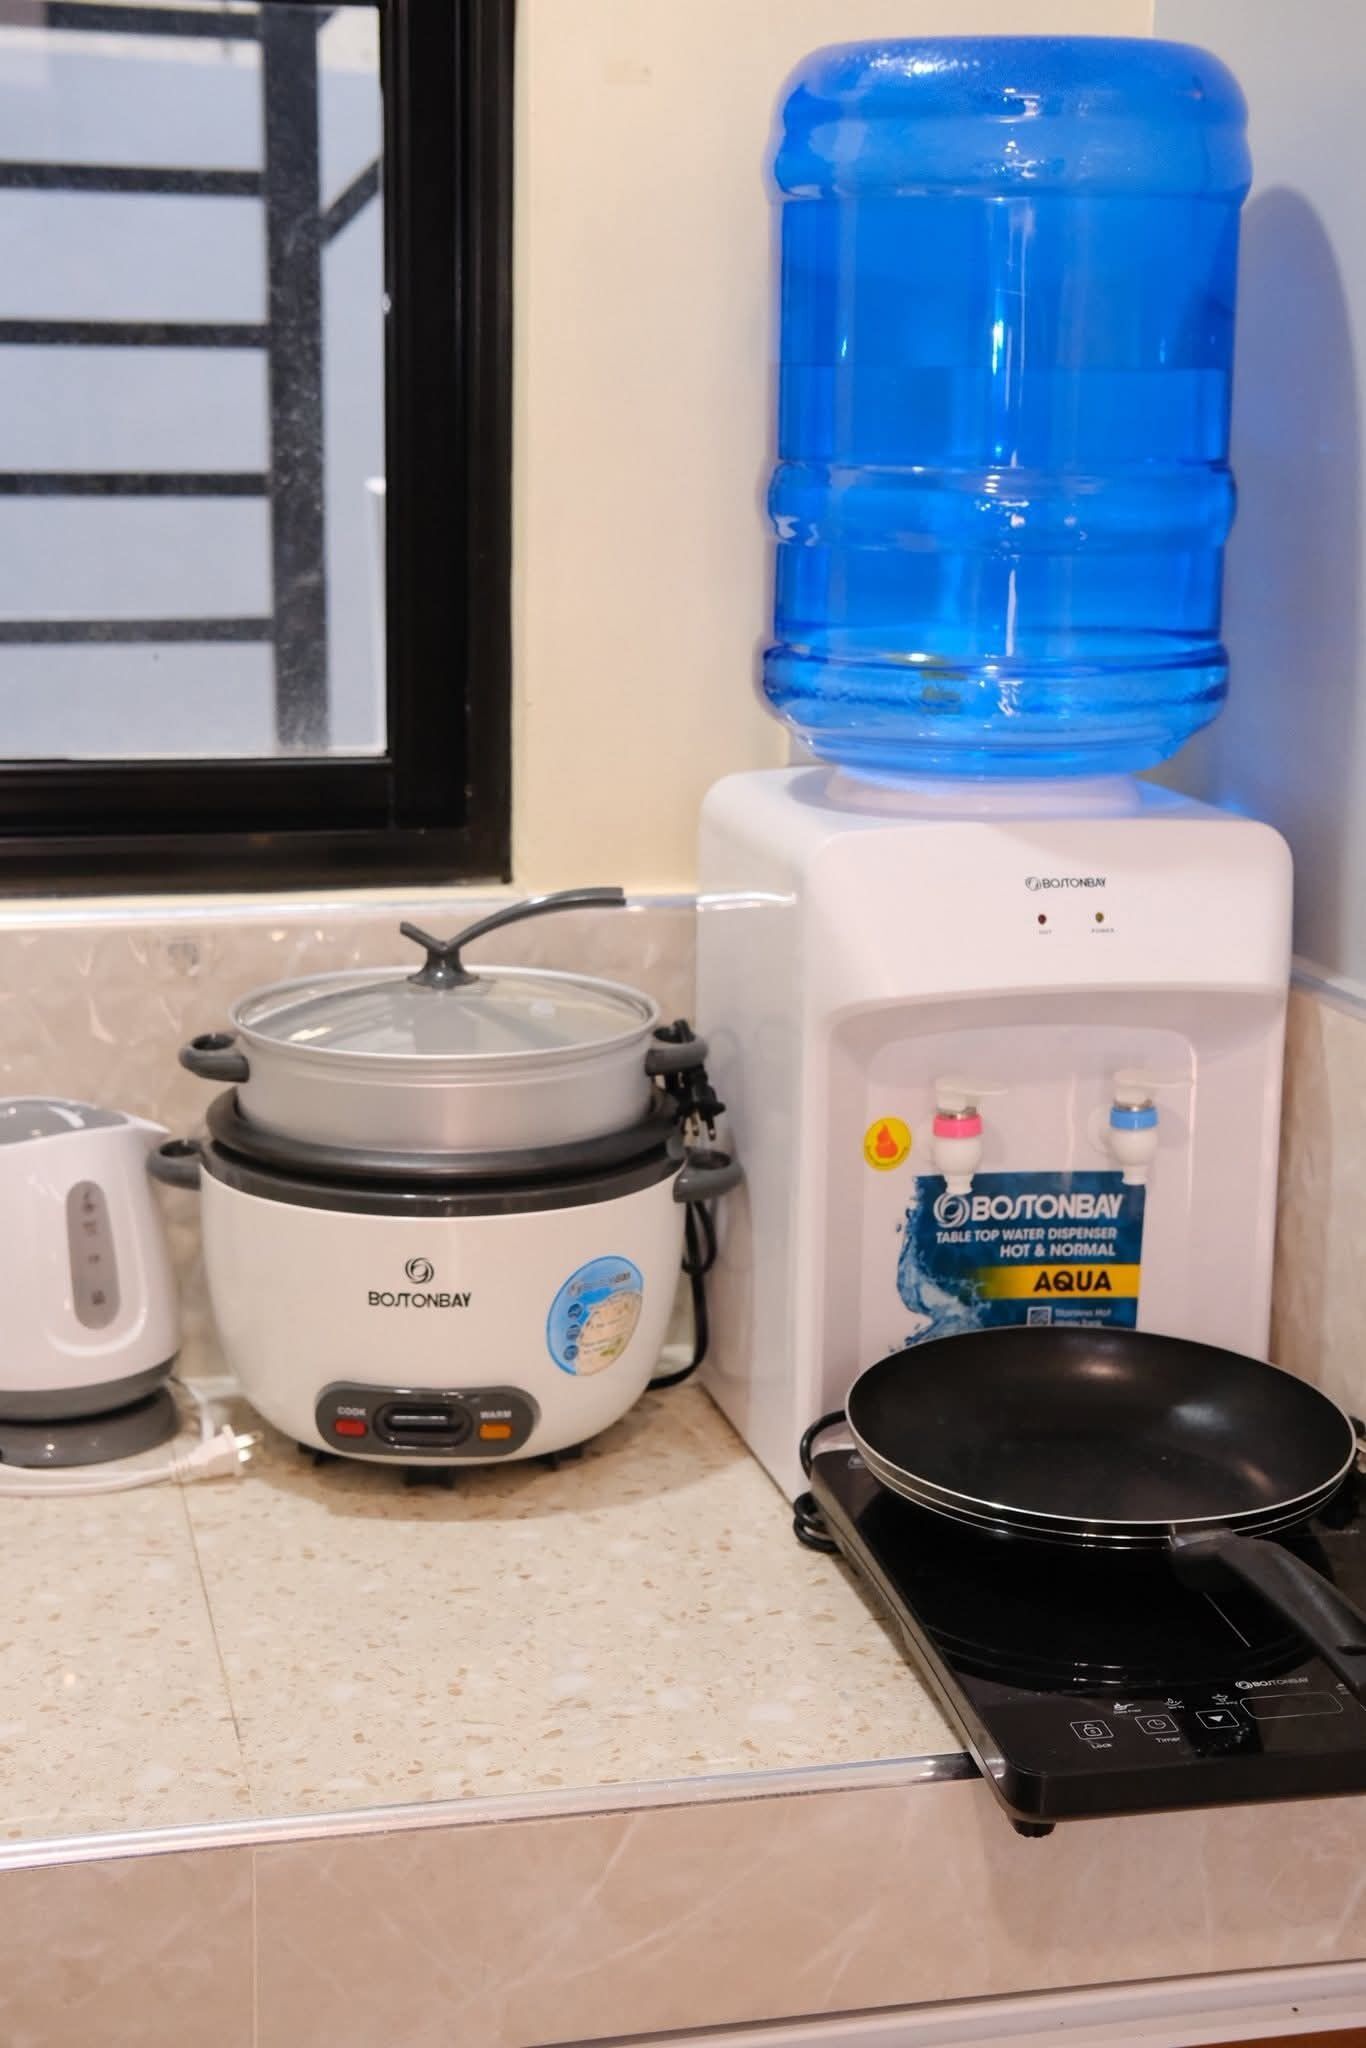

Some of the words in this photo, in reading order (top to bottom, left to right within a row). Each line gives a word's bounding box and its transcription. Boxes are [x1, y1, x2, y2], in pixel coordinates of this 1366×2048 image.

[971, 1194, 1123, 1221] BOSTONBAY
[936, 1231, 972, 1243] TABLE
[975, 1230, 999, 1242] TOP
[1003, 1228, 1045, 1240] WATER
[1048, 1227, 1117, 1239] DISPENSER
[1000, 1244, 1031, 1258] HOT
[1034, 1245, 1046, 1257] &
[1051, 1243, 1117, 1257] NORMAL
[1033, 1271, 1112, 1292] AQUA
[368, 1290, 472, 1308] BOSTONBAY
[337, 1406, 367, 1417] COOK
[480, 1410, 512, 1420] WARM
